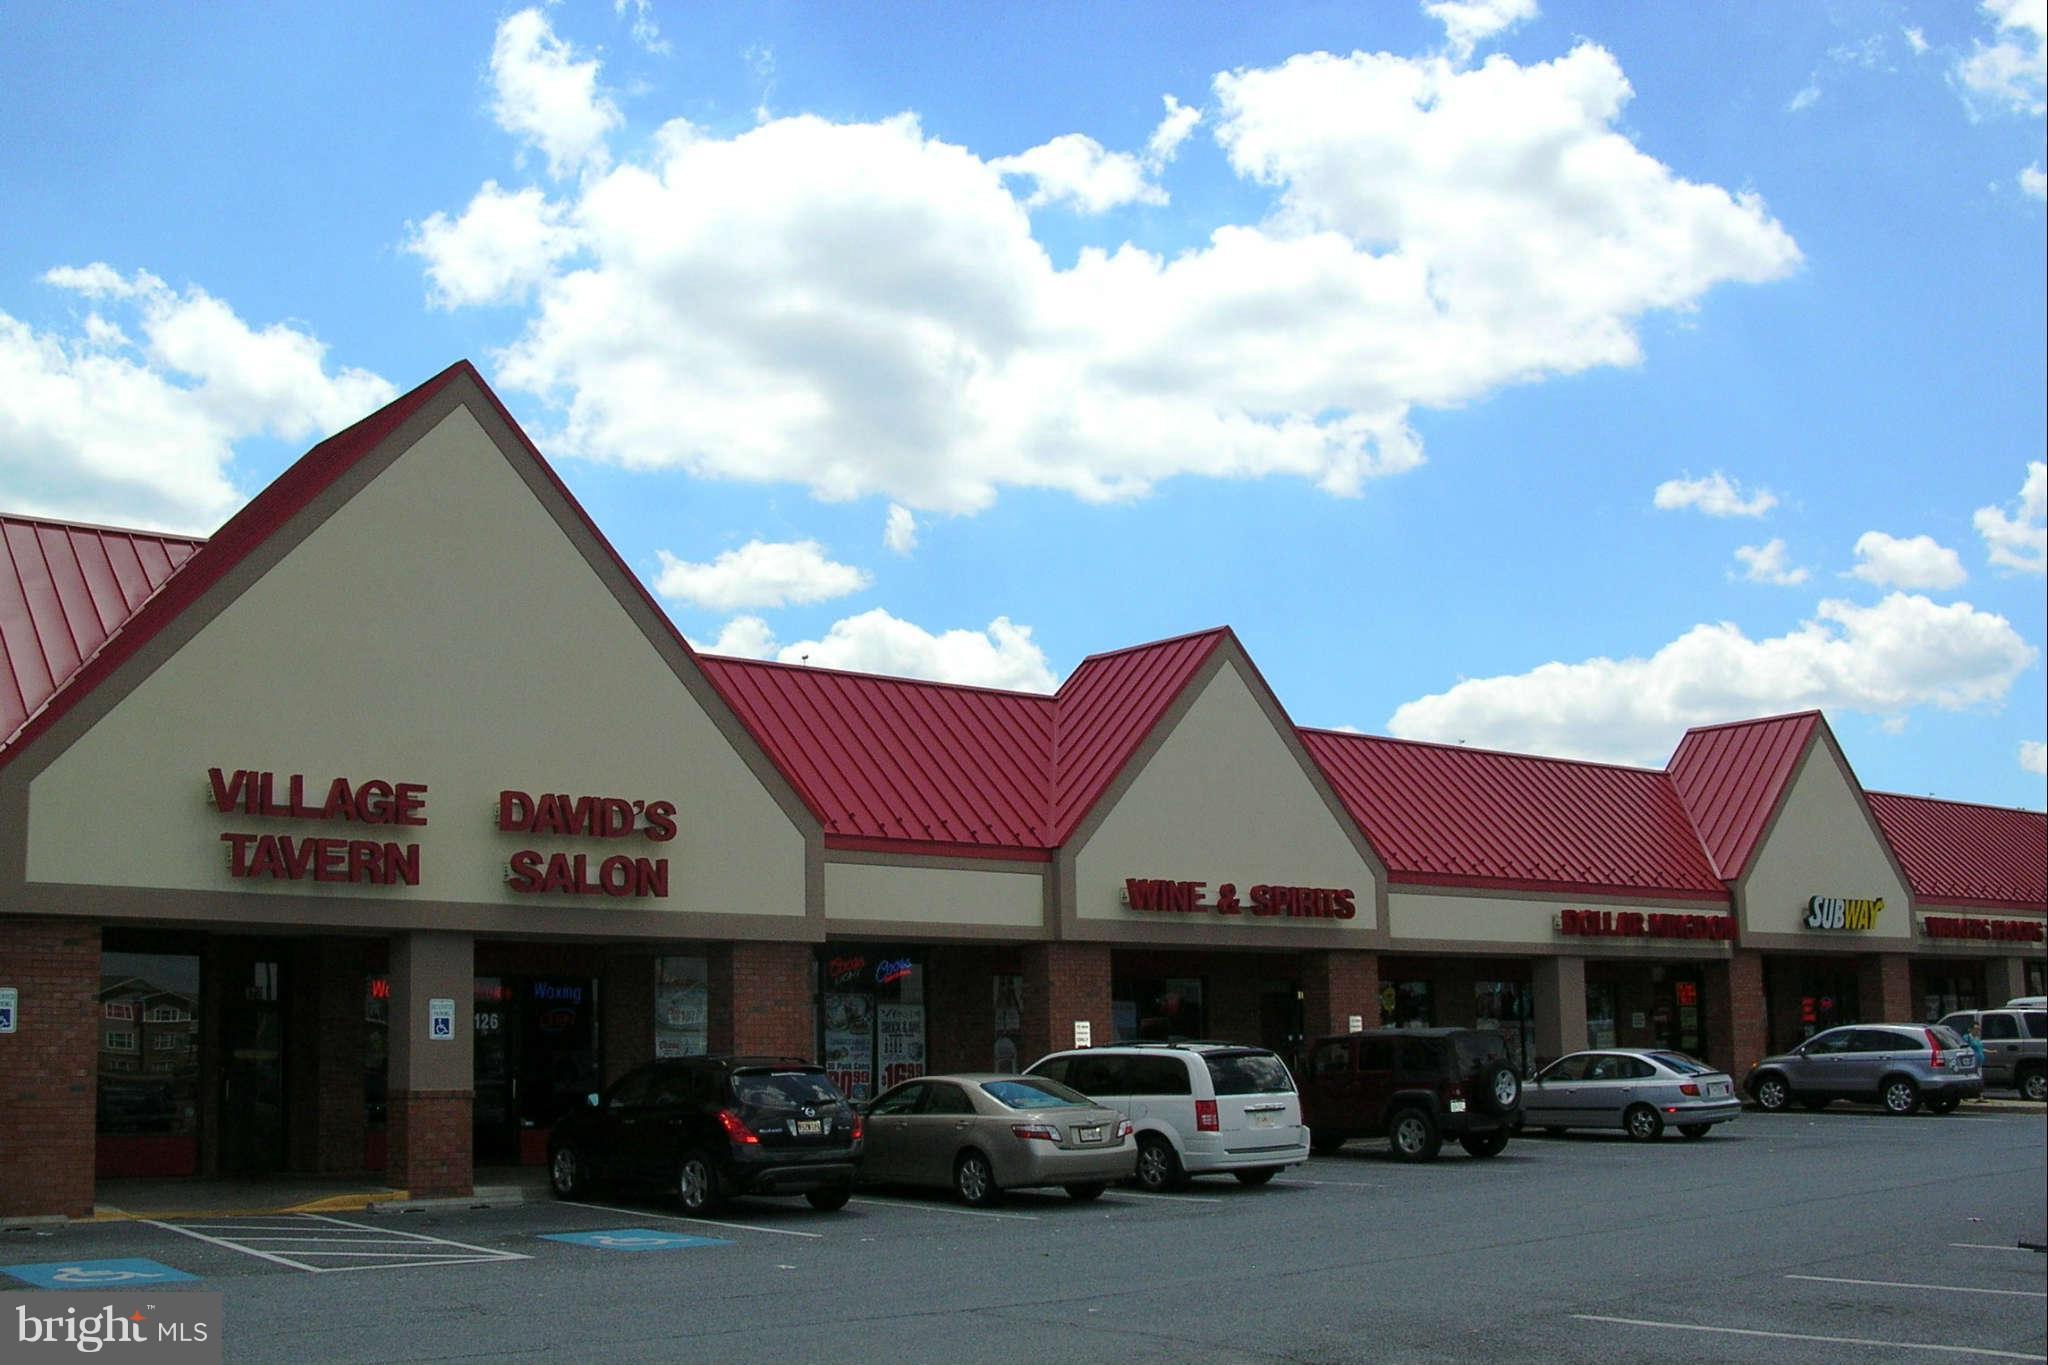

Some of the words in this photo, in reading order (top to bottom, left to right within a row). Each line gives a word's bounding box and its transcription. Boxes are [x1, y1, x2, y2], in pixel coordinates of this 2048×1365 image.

[209, 767, 428, 826] VILLAGE
[499, 790, 677, 842] DAVID'S
[221, 833, 421, 886] TAVERN
[509, 849, 668, 898] SALON
[1126, 878, 1208, 913] WINE
[1216, 883, 1241, 915] &
[1250, 884, 1356, 919] SPIRITS
[1807, 895, 1885, 930] SUBWAY
[1561, 909, 1648, 937] DOLLAR
[532, 980, 582, 1004] Waxing
[474, 1012, 499, 1030] 126
